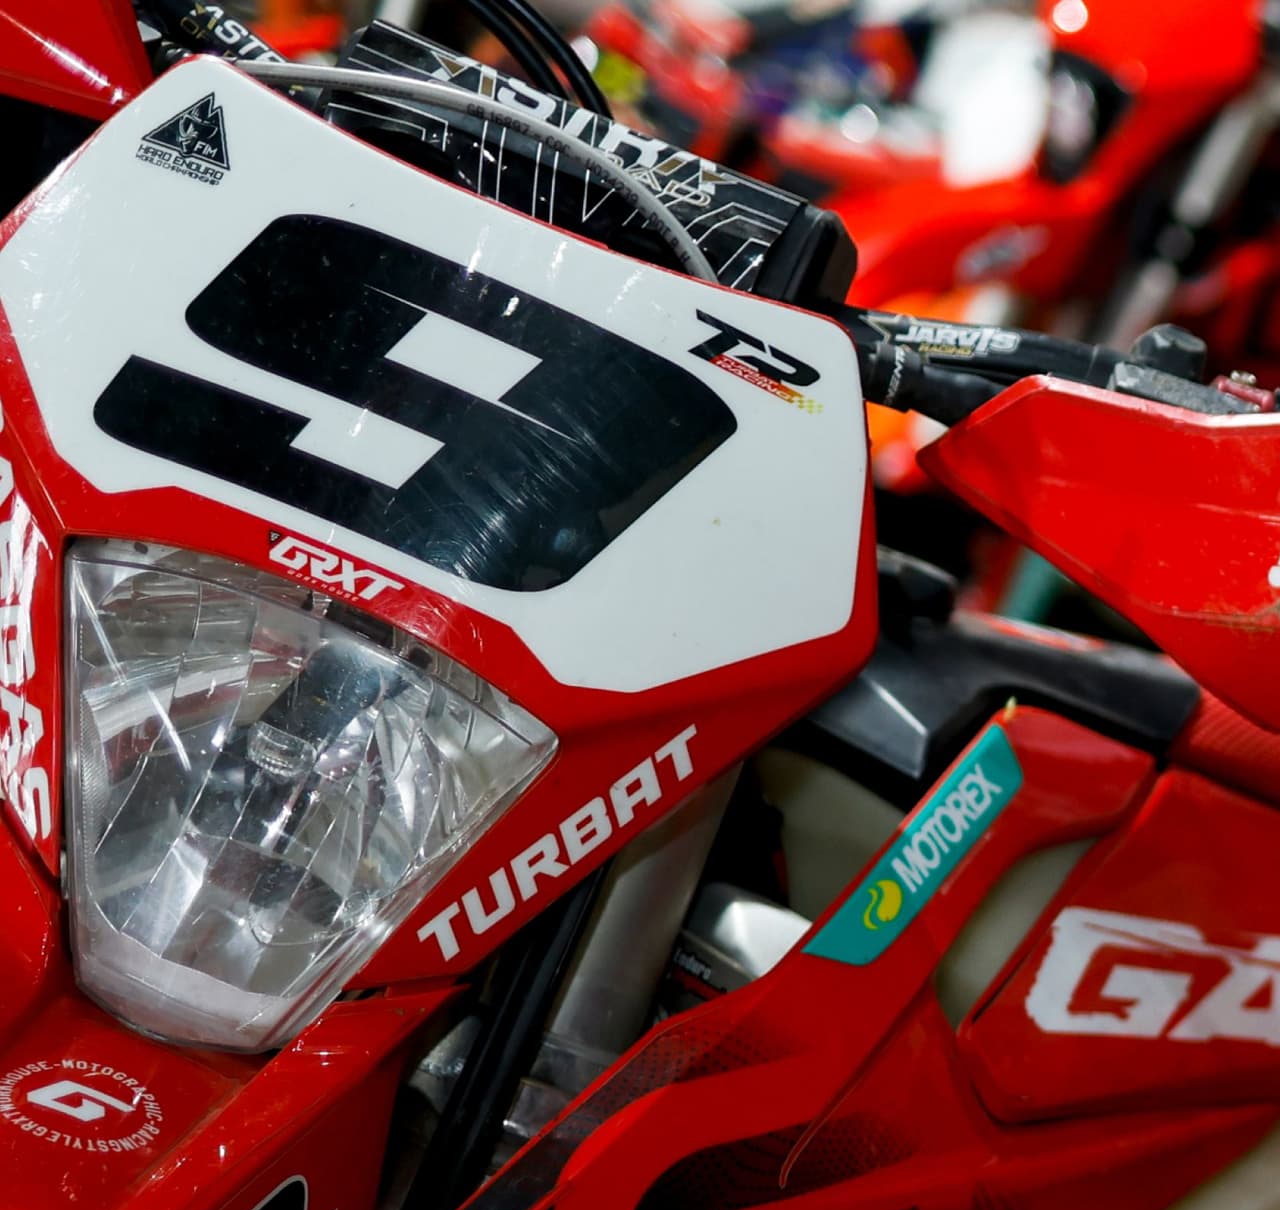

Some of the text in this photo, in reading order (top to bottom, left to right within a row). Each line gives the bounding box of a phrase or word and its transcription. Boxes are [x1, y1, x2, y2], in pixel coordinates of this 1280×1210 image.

[137, 143, 225, 181] HARD ENDURO
[193, 140, 219, 158] FIM
[896, 326, 1020, 352] JARVIS
[94, 214, 738, 592] 9
[269, 536, 405, 601] GRXT
[416, 723, 698, 963] TURBAT
[891, 763, 1003, 894] MOTOREX
